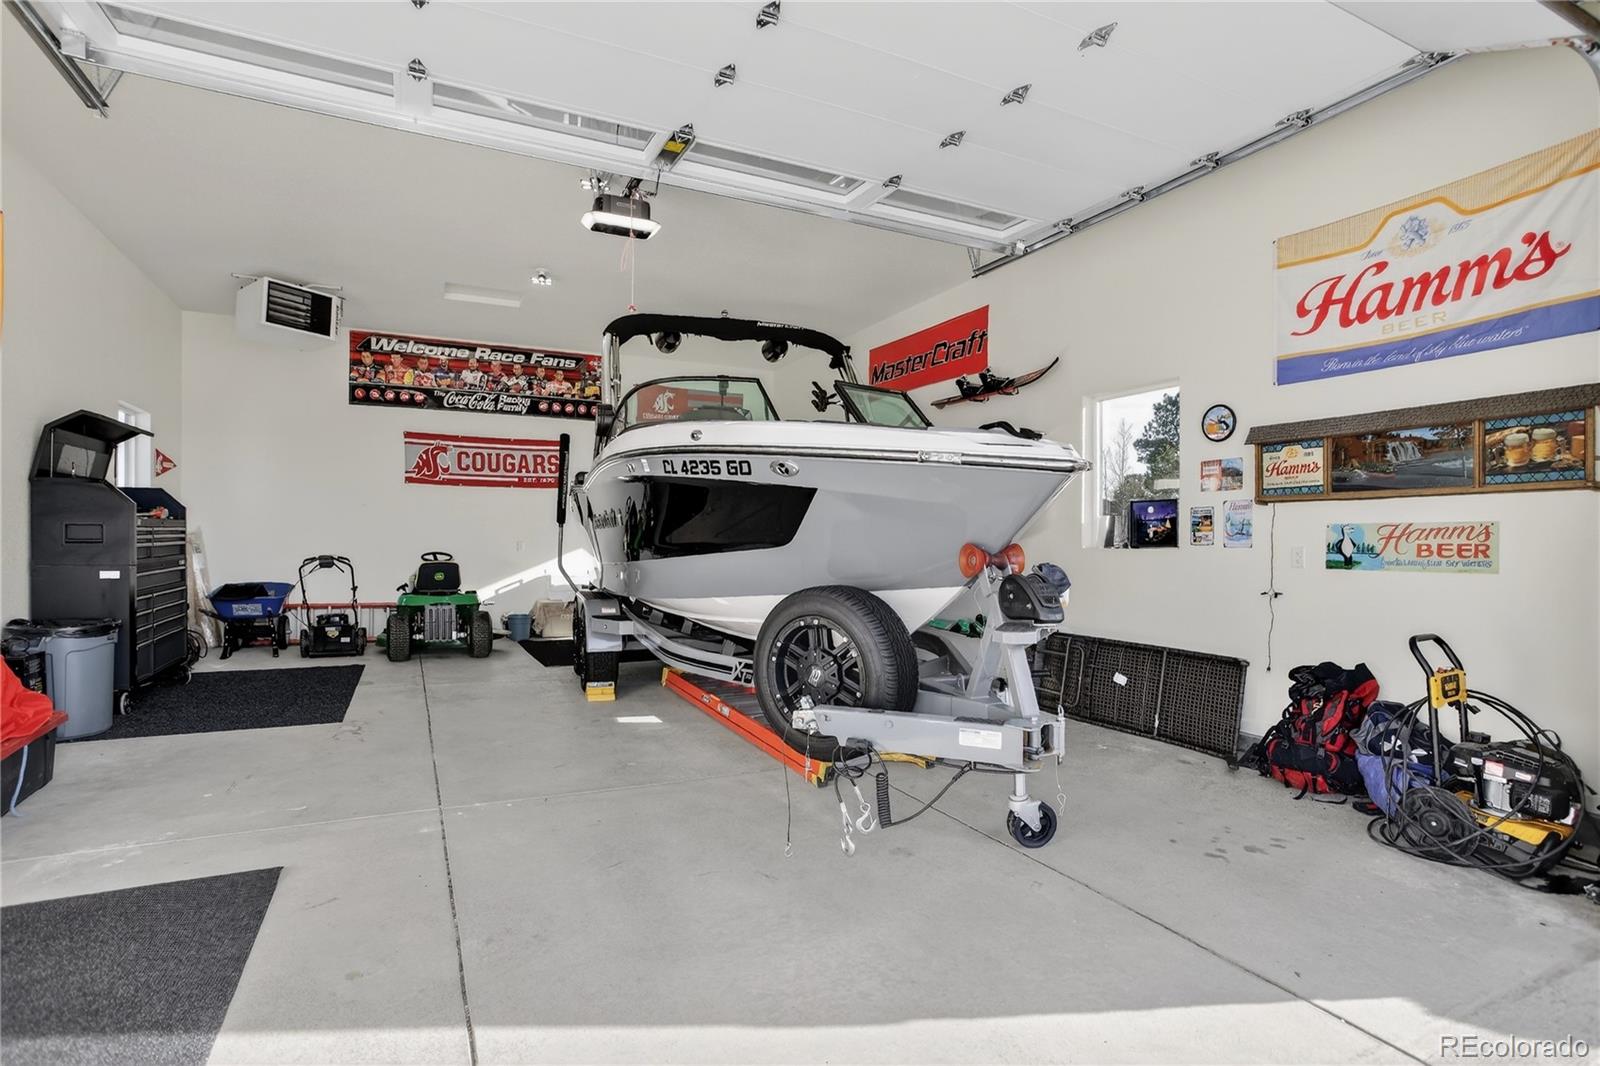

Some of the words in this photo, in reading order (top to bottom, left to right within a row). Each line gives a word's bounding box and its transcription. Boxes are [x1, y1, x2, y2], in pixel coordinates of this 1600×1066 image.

[1290, 230, 1572, 337] Hamm's
[1381, 311, 1447, 335] BEER
[1477, 327, 1524, 345] waters
[369, 336, 470, 358] Welcome
[475, 347, 526, 363] Race
[530, 352, 577, 368] Fans
[871, 329, 988, 385] MasterCraft
[497, 402, 530, 415] Family
[499, 394, 531, 407] Racing
[456, 451, 560, 474] COUGARS
[662, 460, 678, 475] CL
[681, 460, 721, 475] 4235
[1265, 460, 1321, 478] Hamm's
[1368, 522, 1494, 559] Hamm's
[1416, 543, 1491, 560] BEER
